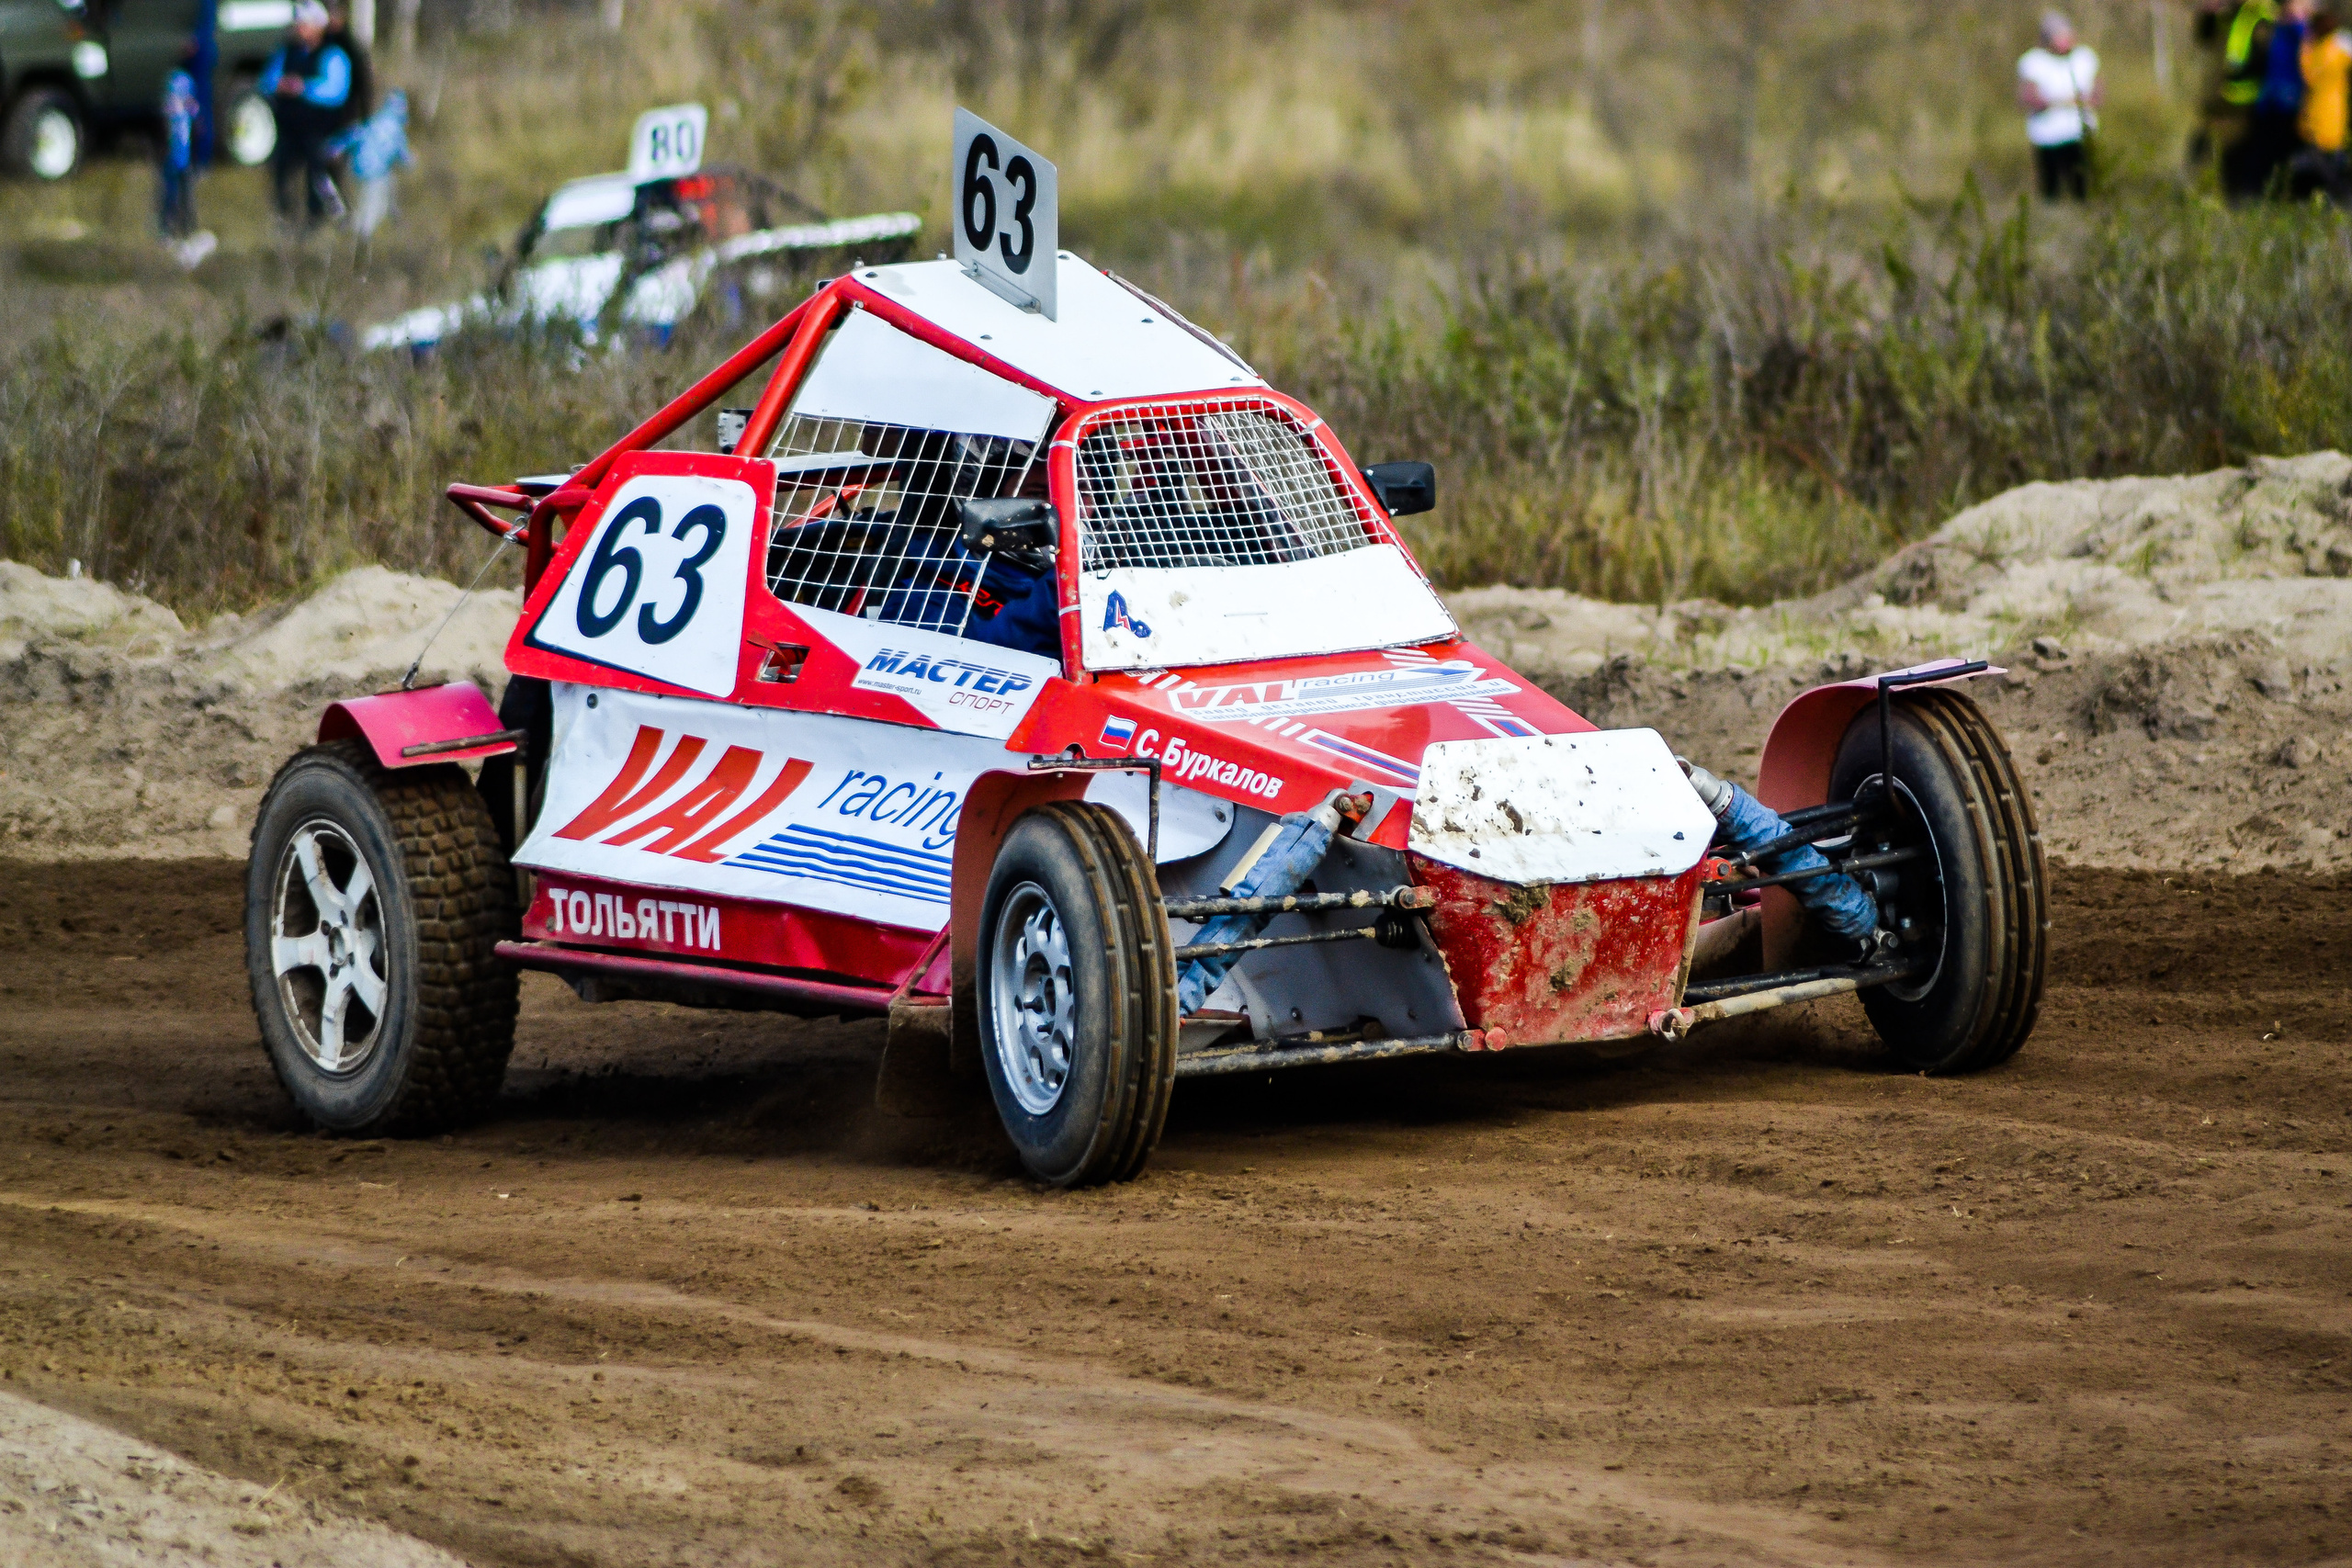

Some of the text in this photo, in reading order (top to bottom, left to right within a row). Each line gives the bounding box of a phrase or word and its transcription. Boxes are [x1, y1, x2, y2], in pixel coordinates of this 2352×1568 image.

[650, 121, 695, 164] 80
[963, 133, 1036, 275] 63
[576, 496, 728, 645] 63
[857, 679, 922, 695] www.master-sport.ru
[865, 648, 1033, 695] МАСТЕР
[1177, 671, 1396, 709] VAL racing
[949, 692, 1014, 715] СПОРТ
[551, 724, 815, 863] VAL
[548, 888, 721, 951] ТОЛЬЯТТИ
